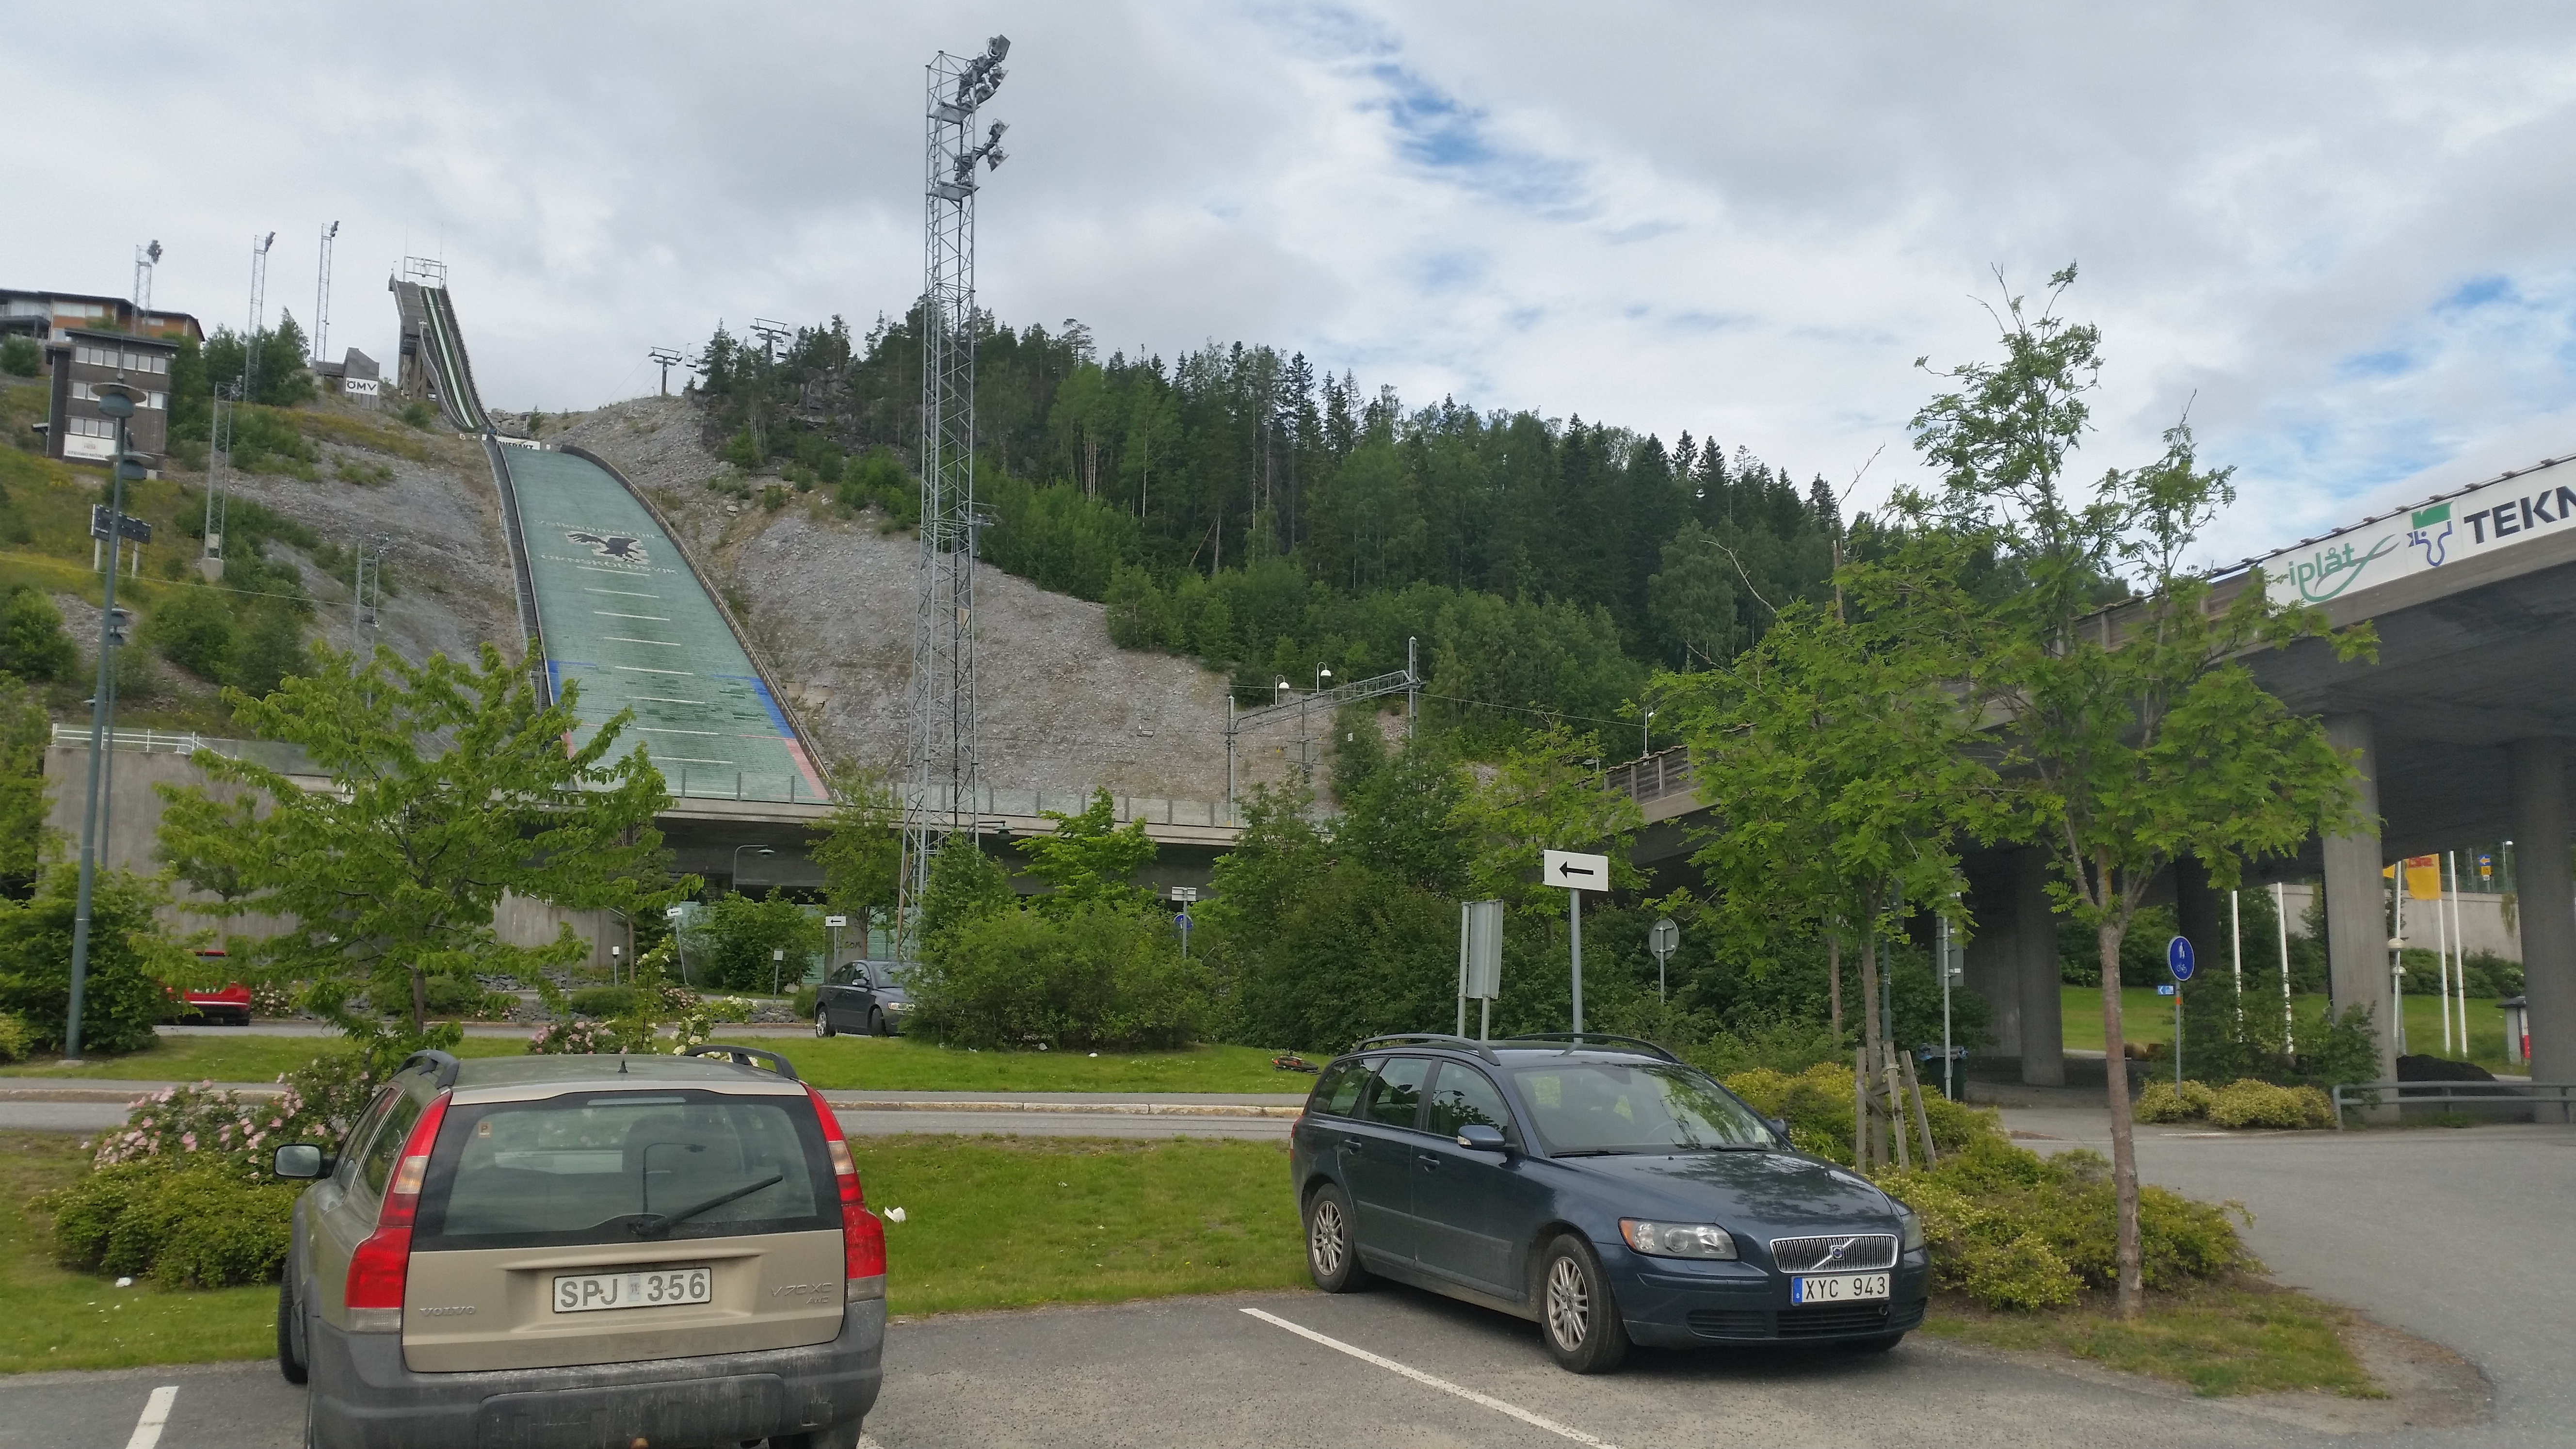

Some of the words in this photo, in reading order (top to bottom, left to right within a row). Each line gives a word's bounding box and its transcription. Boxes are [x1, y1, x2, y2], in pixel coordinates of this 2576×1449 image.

[347, 380, 377, 391] ÖMV
[2463, 485, 2576, 544] TEKN
[2288, 543, 2357, 602] iplåt
[561, 1278, 617, 1308] SPJ
[647, 1273, 706, 1302] 356
[1805, 1279, 1838, 1299] XYC
[1853, 1276, 1885, 1296] 943
[419, 1306, 476, 1317] VOLVO
